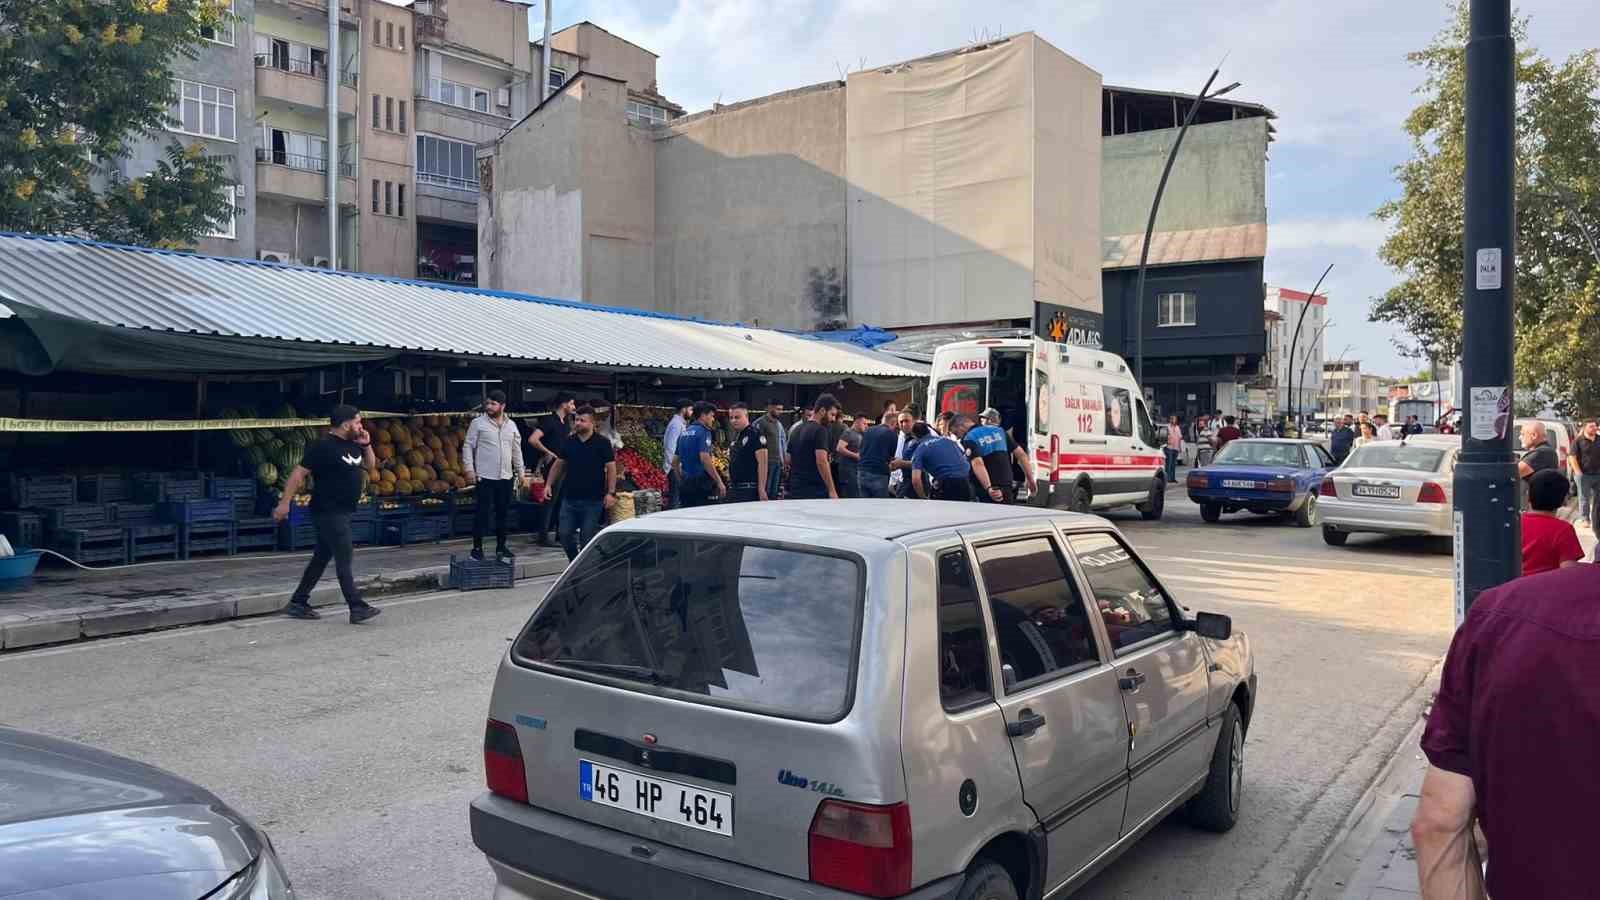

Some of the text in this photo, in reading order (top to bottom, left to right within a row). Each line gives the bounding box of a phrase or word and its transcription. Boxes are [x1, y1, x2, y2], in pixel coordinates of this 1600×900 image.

[950, 360, 987, 371] AMBU
[1077, 413, 1093, 433] 112
[593, 768, 723, 830] 46 HP 464
